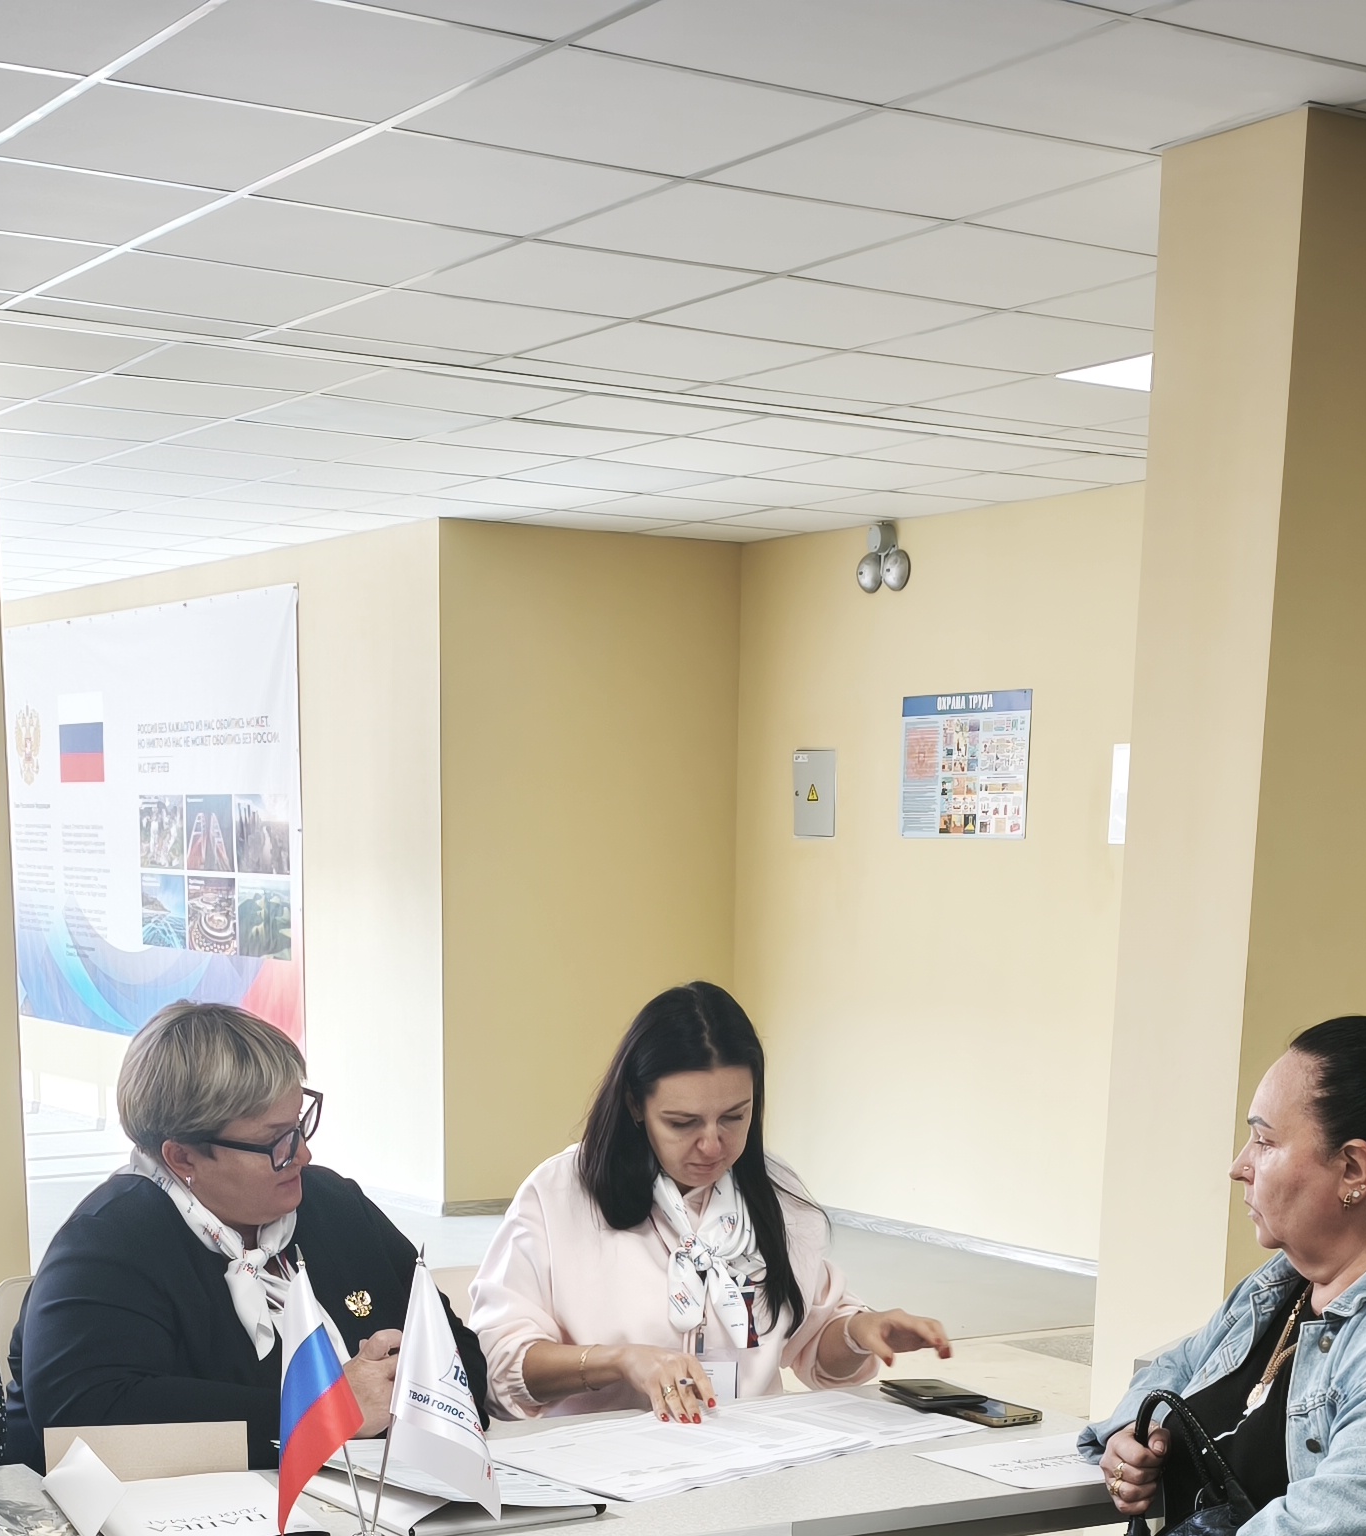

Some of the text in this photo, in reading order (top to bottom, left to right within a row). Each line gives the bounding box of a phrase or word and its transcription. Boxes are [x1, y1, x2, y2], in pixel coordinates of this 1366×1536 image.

[937, 694, 993, 711] ОХРАНА ТРУДА
[409, 1389, 430, 1404] ТВОЙ
[431, 1399, 465, 1420] ГОЛОС
